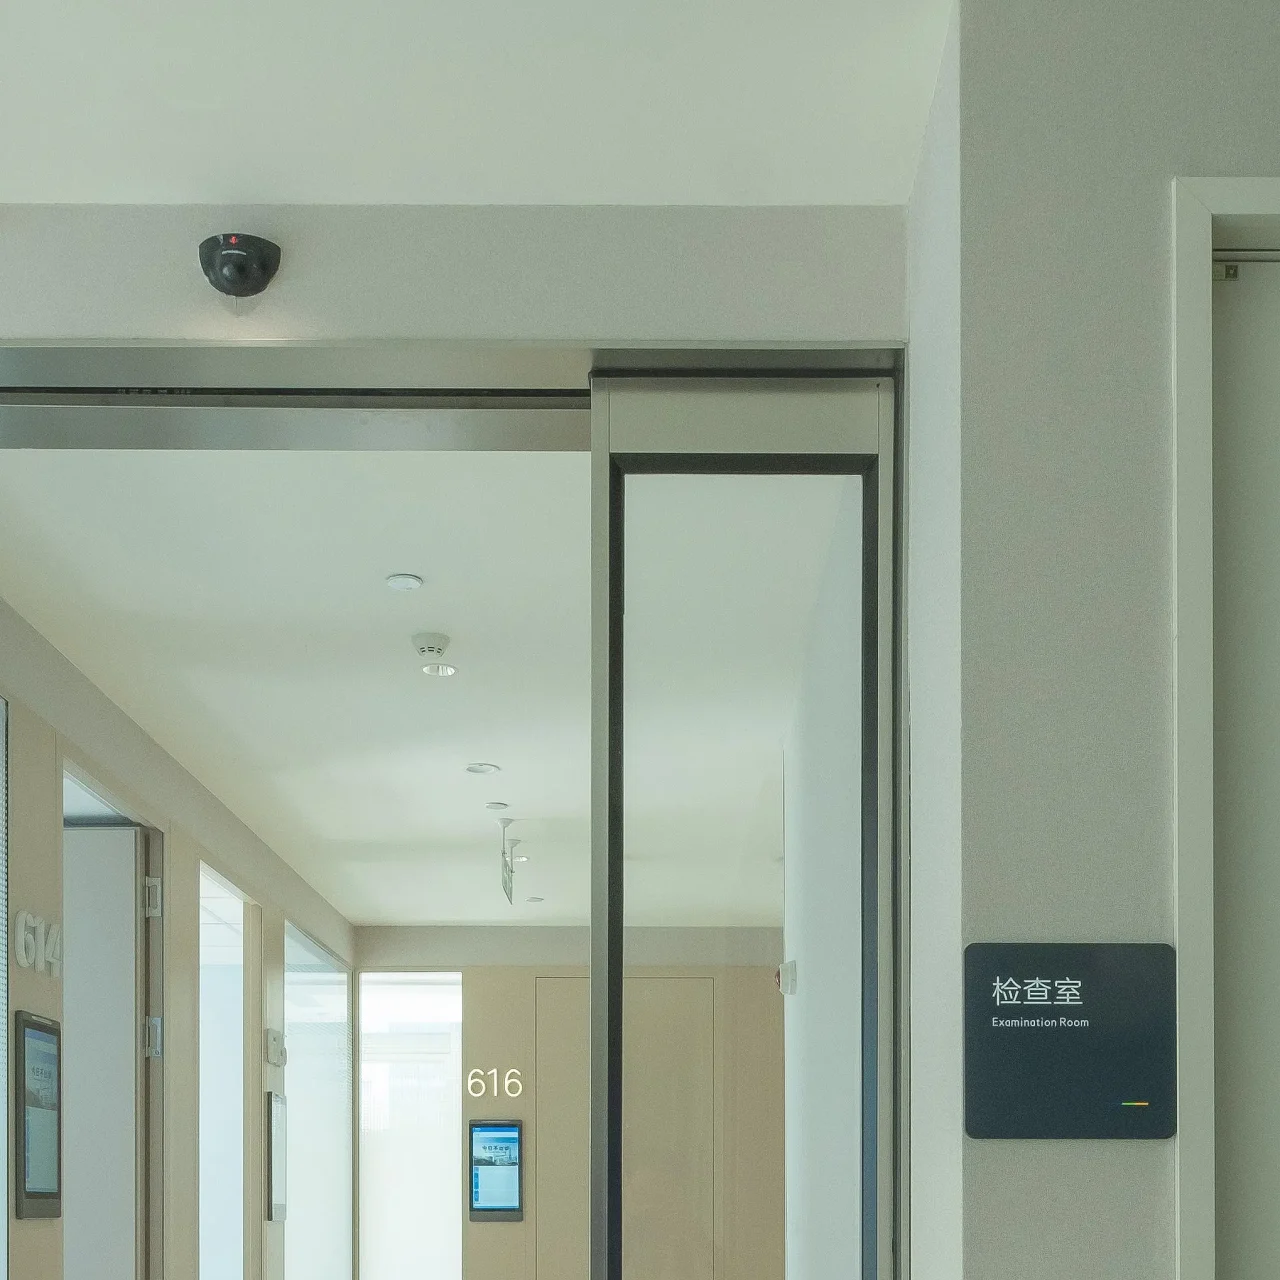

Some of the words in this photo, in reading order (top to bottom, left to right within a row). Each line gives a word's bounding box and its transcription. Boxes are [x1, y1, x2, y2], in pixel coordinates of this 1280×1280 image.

[14, 909, 62, 978] 614
[992, 976, 1083, 1006] 检查室
[992, 1016, 1057, 1027] Examination
[1059, 1017, 1090, 1027] Room
[467, 1068, 523, 1097] 616
